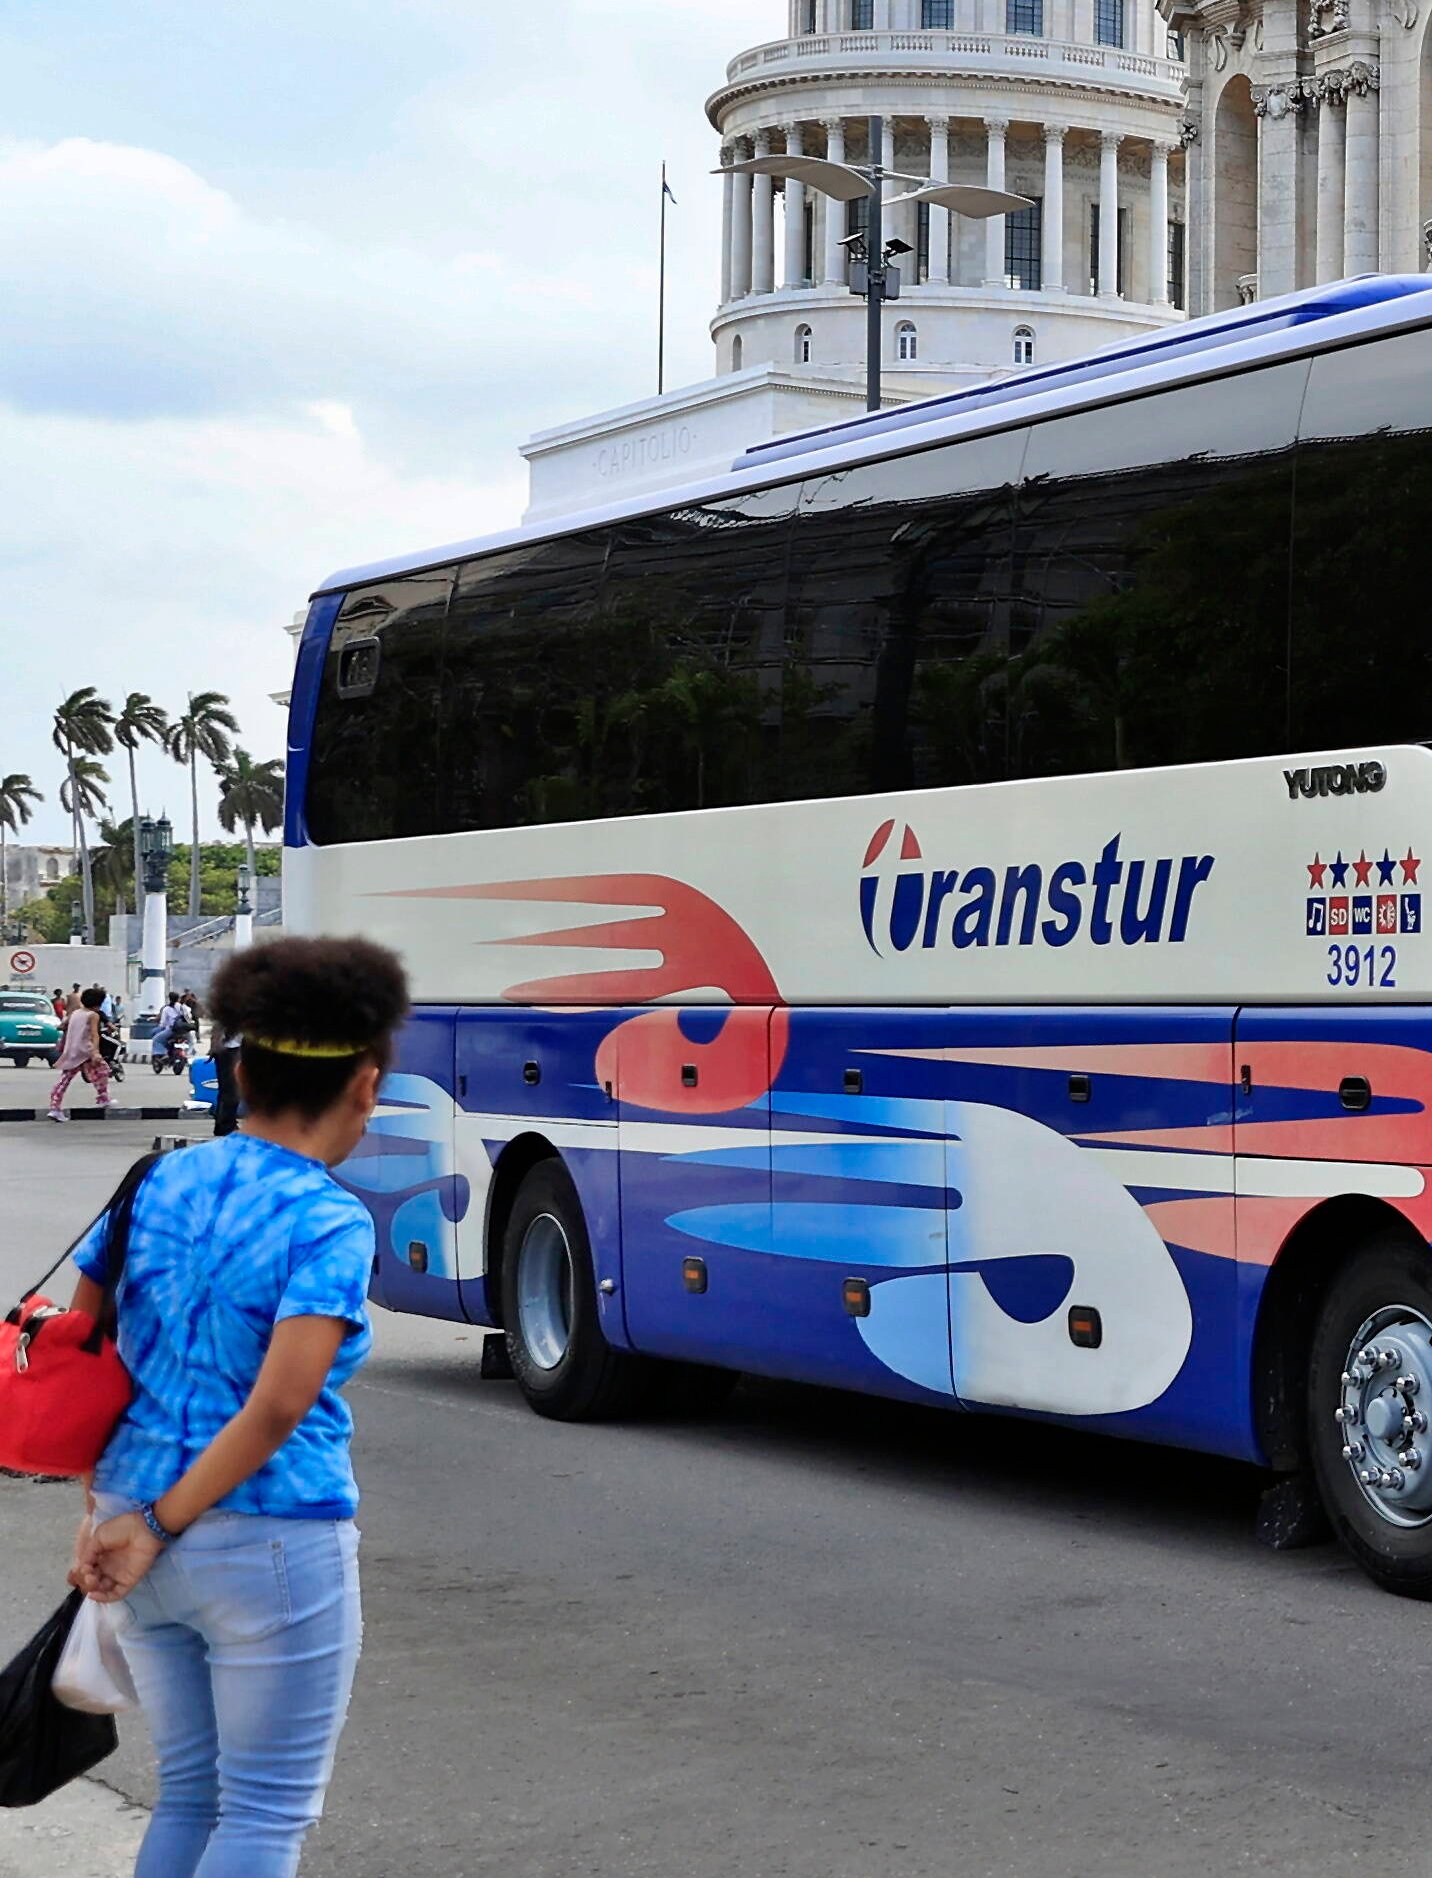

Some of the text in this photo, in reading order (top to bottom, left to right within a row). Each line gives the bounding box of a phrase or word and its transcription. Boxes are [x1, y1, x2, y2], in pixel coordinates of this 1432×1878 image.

[598, 426, 690, 476] CAPITOLIO
[1283, 761, 1387, 799] YUTONG
[1330, 907, 1371, 926] SD WC
[1327, 944, 1396, 988] 3912
